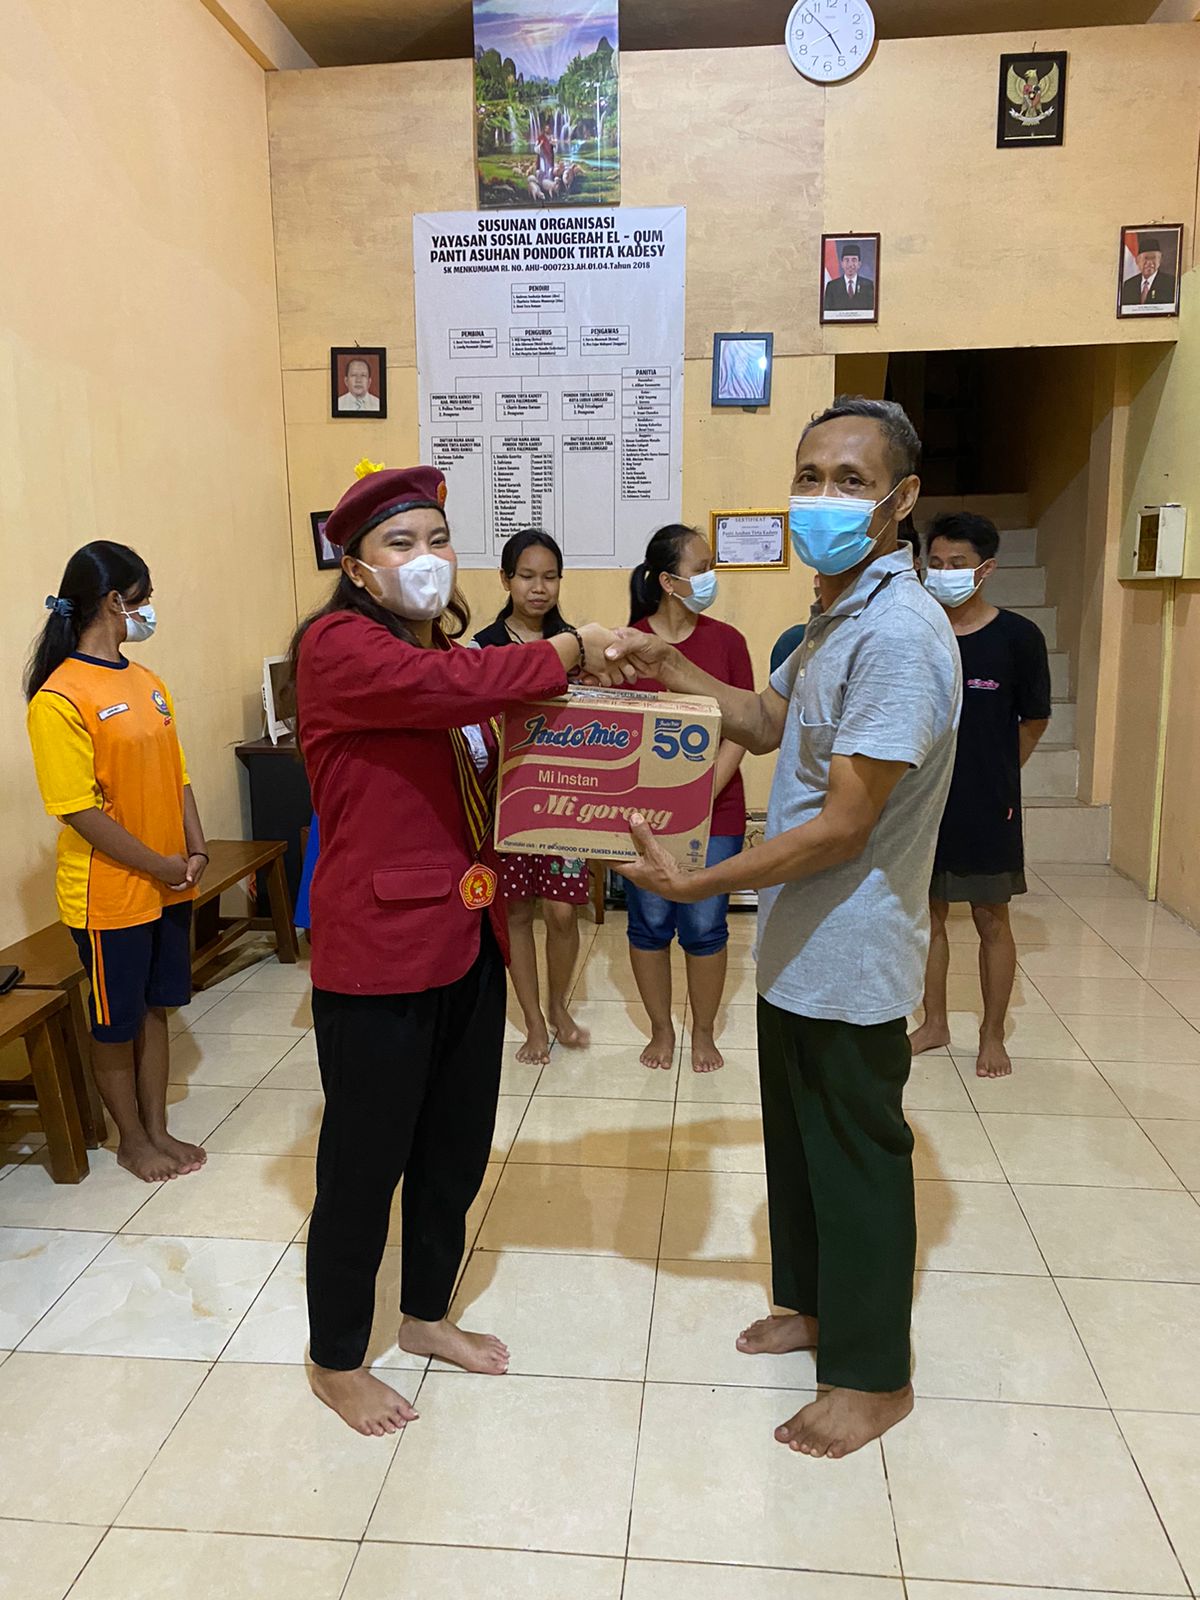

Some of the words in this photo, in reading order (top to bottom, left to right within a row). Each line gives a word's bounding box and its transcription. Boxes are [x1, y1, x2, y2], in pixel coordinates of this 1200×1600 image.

[814, 3, 820, 13] 11
[844, 3, 848, 13] 1
[801, 13, 814, 24] 10
[852, 13, 861, 25] 2
[795, 29, 804, 40] 9
[855, 29, 864, 40] 3
[799, 44, 808, 55] 8
[849, 45, 857, 55] 4
[811, 55, 819, 66] 7
[823, 60, 832, 72] 6
[838, 55, 846, 67] 5
[477, 218, 537, 232] SUSUNAN
[540, 216, 615, 230] ORGANISASI
[431, 233, 488, 248] YAYASAN
[490, 232, 533, 247] SOSIAL
[535, 231, 604, 246] ANUGERAH
[607, 231, 621, 244] EL
[633, 229, 664, 247] QUM
[430, 249, 466, 263] PANTI
[469, 247, 520, 262] ASUHAN
[523, 246, 576, 260] PONDOK
[578, 245, 615, 259] TIRTA
[617, 244, 666, 258] KADESY
[443, 266, 453, 274] SK
[453, 264, 500, 273] MENKUMHAM
[511, 263, 524, 272] NO.
[633, 260, 651, 269] 2018
[528, 284, 550, 292] PENDIRI
[635, 368, 657, 376] PANITIA
[651, 724, 710, 760] 50
[538, 769, 554, 783] Mi
[557, 771, 599, 787] Instan
[533, 794, 579, 816] Mi
